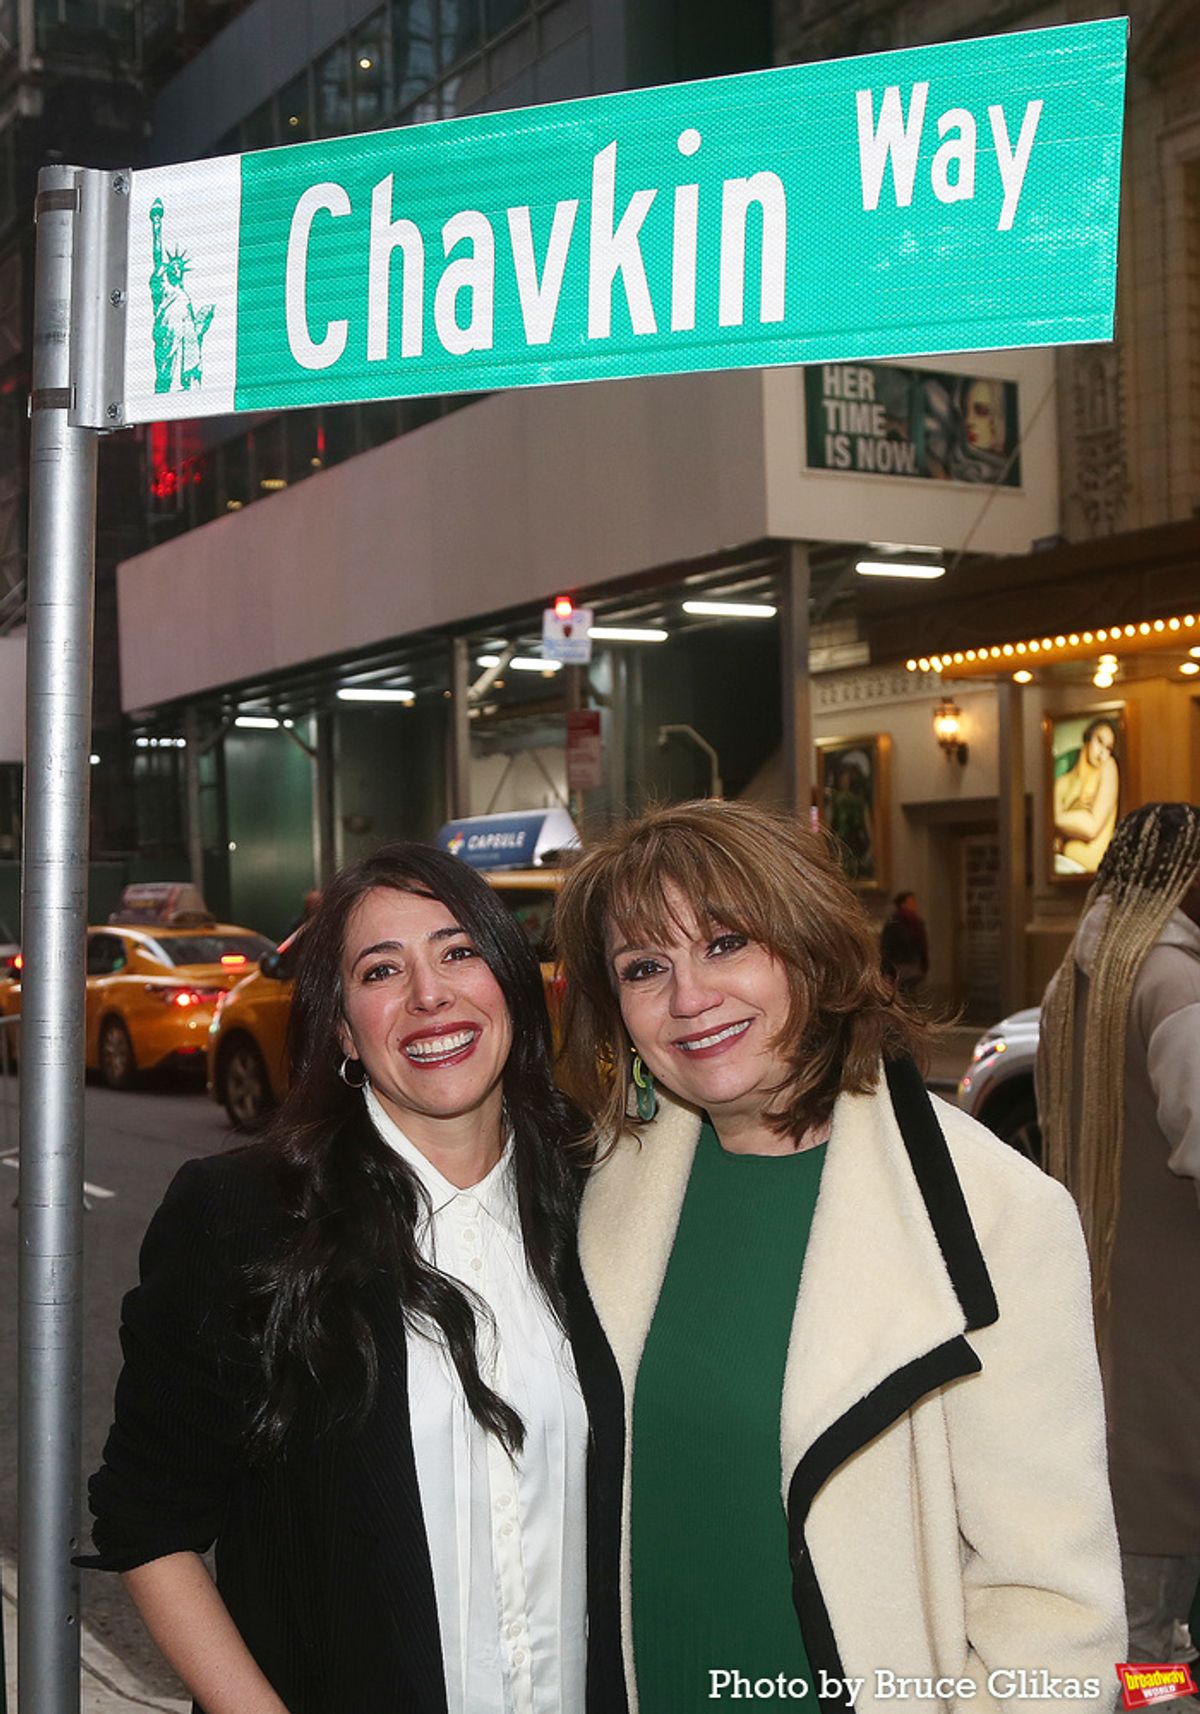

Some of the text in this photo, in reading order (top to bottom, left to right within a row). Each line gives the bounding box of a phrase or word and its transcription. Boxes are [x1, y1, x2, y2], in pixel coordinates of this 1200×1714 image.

[285, 81, 1043, 371] Chavkin Way
[823, 365, 875, 399] HER
[822, 401, 887, 437] TIME
[824, 434, 851, 467] IS
[467, 831, 526, 850] CAPSULE
